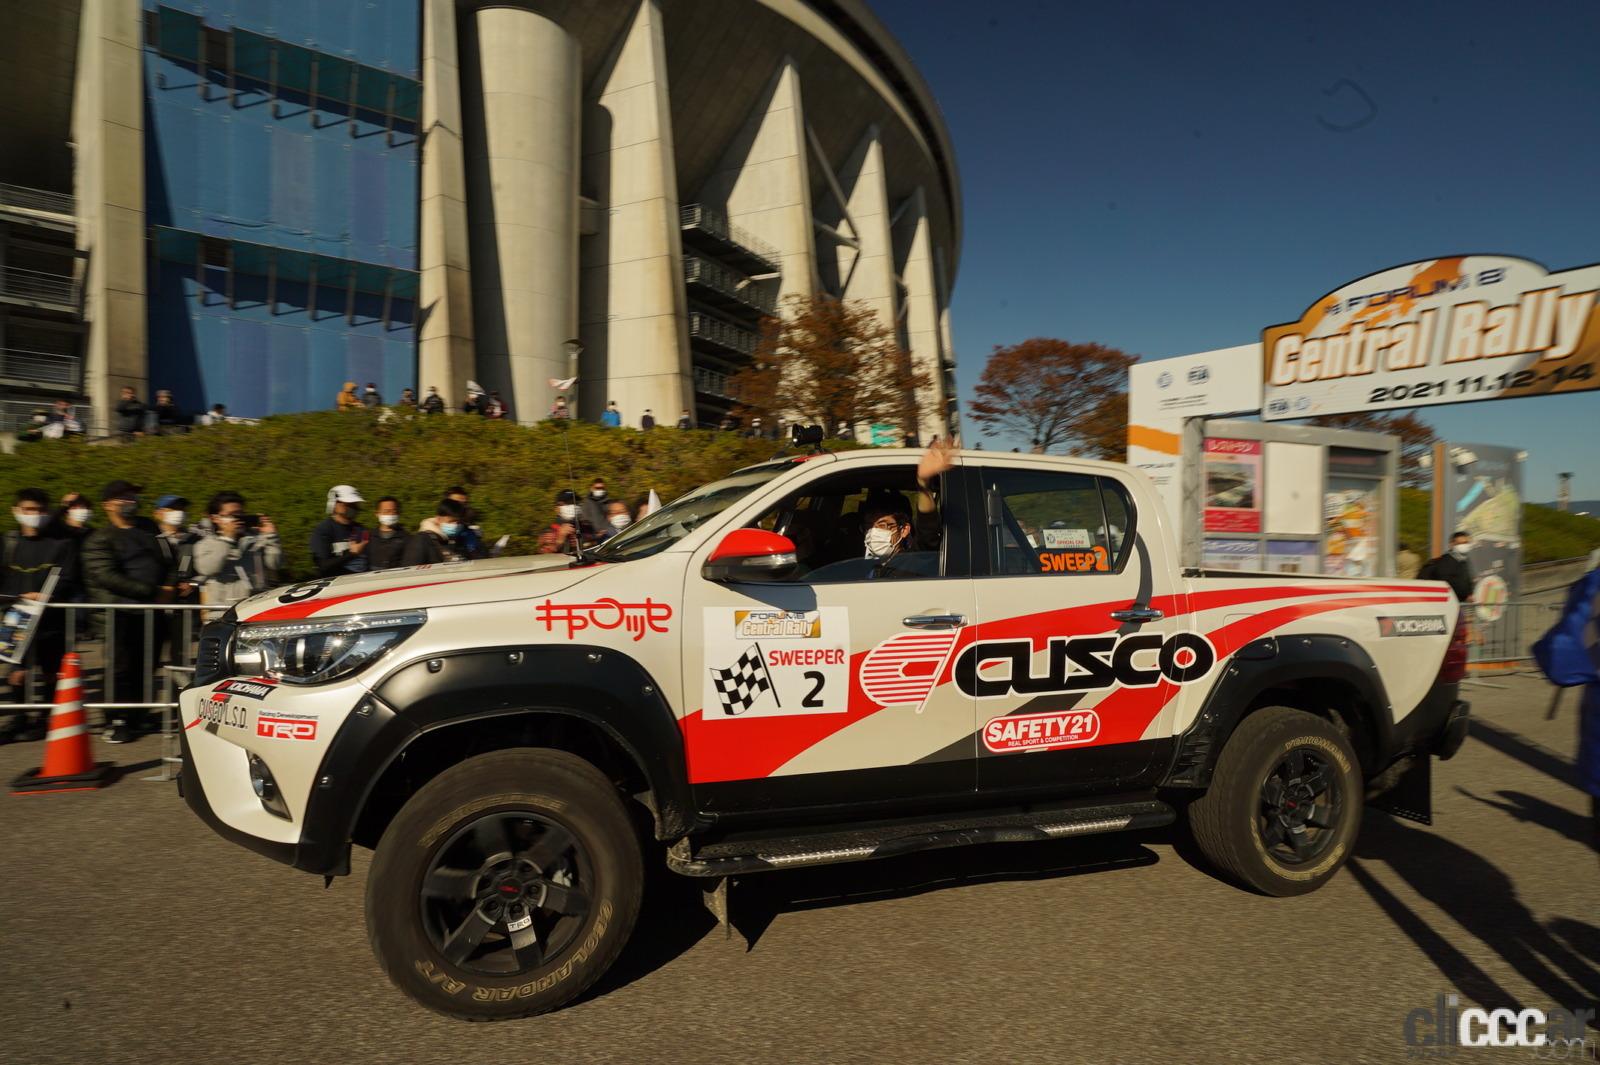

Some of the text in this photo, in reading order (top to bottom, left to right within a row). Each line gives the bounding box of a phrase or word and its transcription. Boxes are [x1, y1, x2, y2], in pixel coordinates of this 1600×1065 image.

[1272, 285, 1600, 386] Central Rally
[1366, 380, 1446, 403] 2021
[743, 619, 815, 638] Central Rally
[769, 649, 845, 666] SWEEPER
[953, 631, 1216, 700] CUSCO
[801, 671, 826, 708] 2
[257, 720, 314, 740] TRD
[1022, 738, 1039, 746] SPORT
[1046, 734, 1079, 744] COMPETITION
[509, 917, 531, 930] TRD
